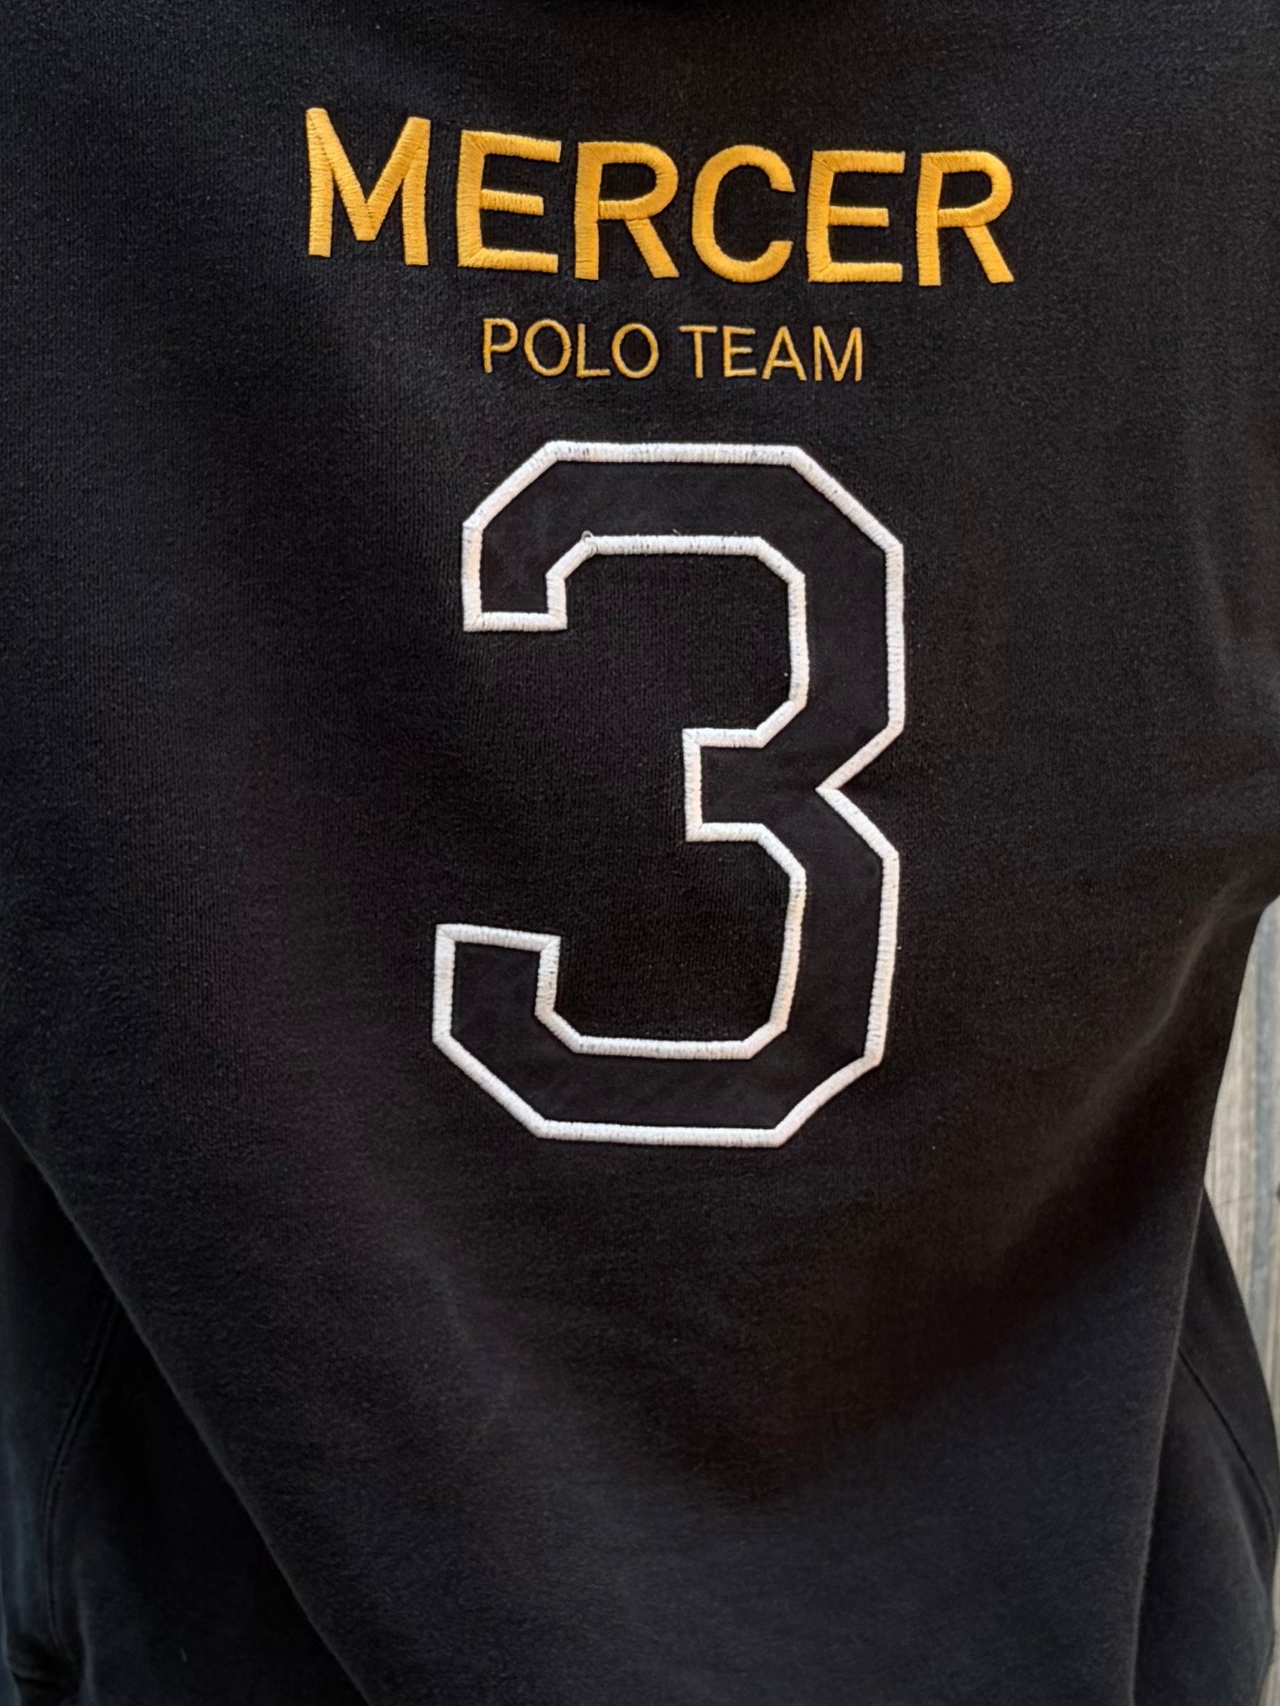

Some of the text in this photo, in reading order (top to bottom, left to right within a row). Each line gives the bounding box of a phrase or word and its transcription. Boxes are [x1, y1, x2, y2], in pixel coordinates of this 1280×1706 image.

[305, 107, 1014, 286] MERCER
[481, 317, 865, 382] POLO TEAM
[432, 440, 906, 1148] 3
